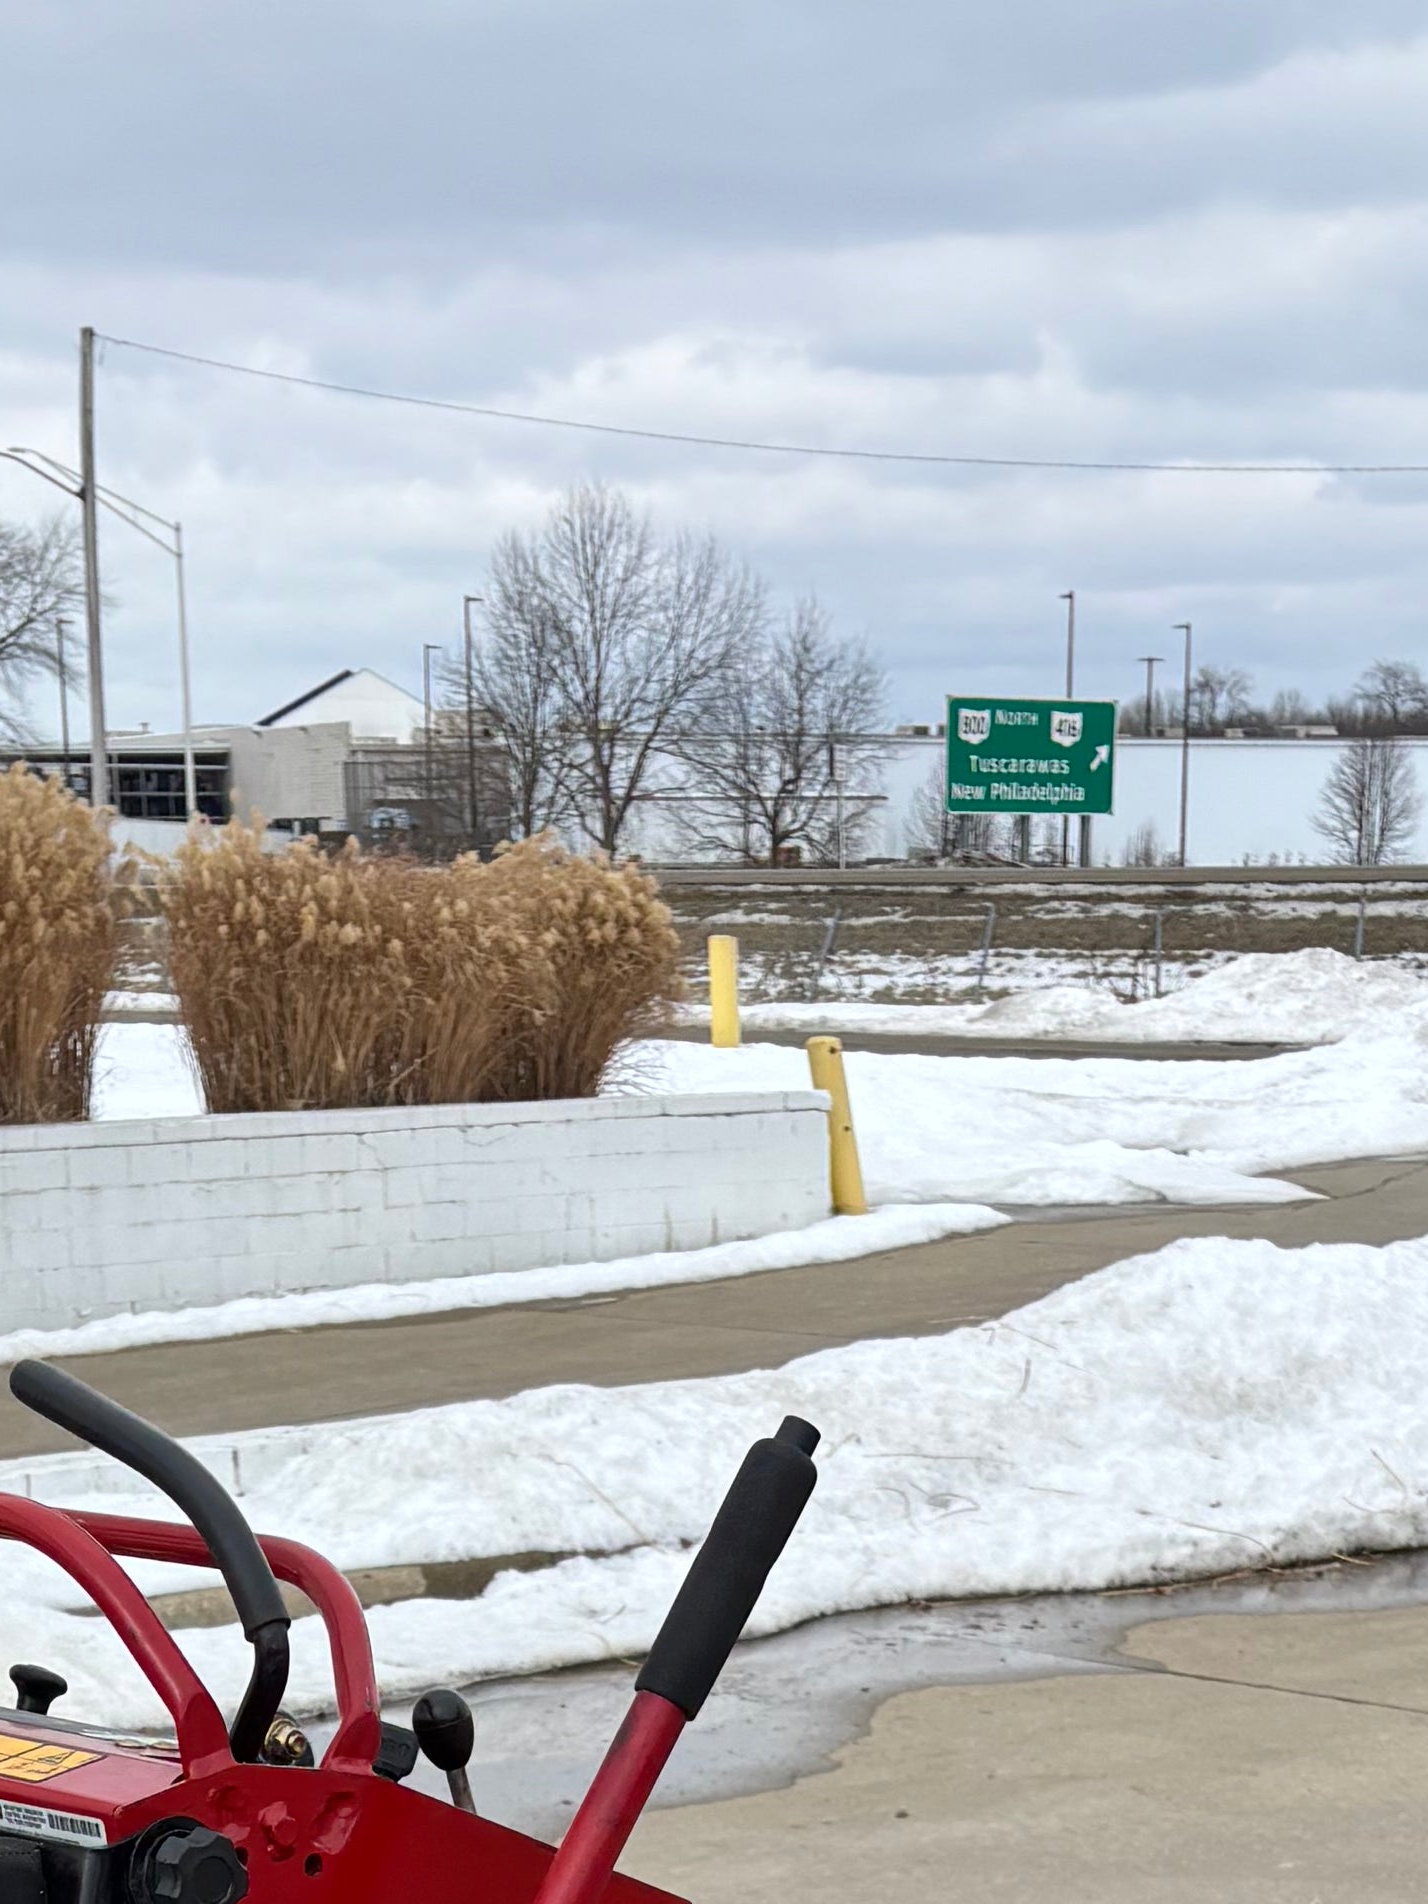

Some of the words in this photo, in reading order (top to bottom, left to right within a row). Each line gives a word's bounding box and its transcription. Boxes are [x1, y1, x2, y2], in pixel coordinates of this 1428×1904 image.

[969, 755, 1070, 774] Tuscarawas
[951, 782, 986, 800] New
[990, 782, 1085, 806] Philadelphia
